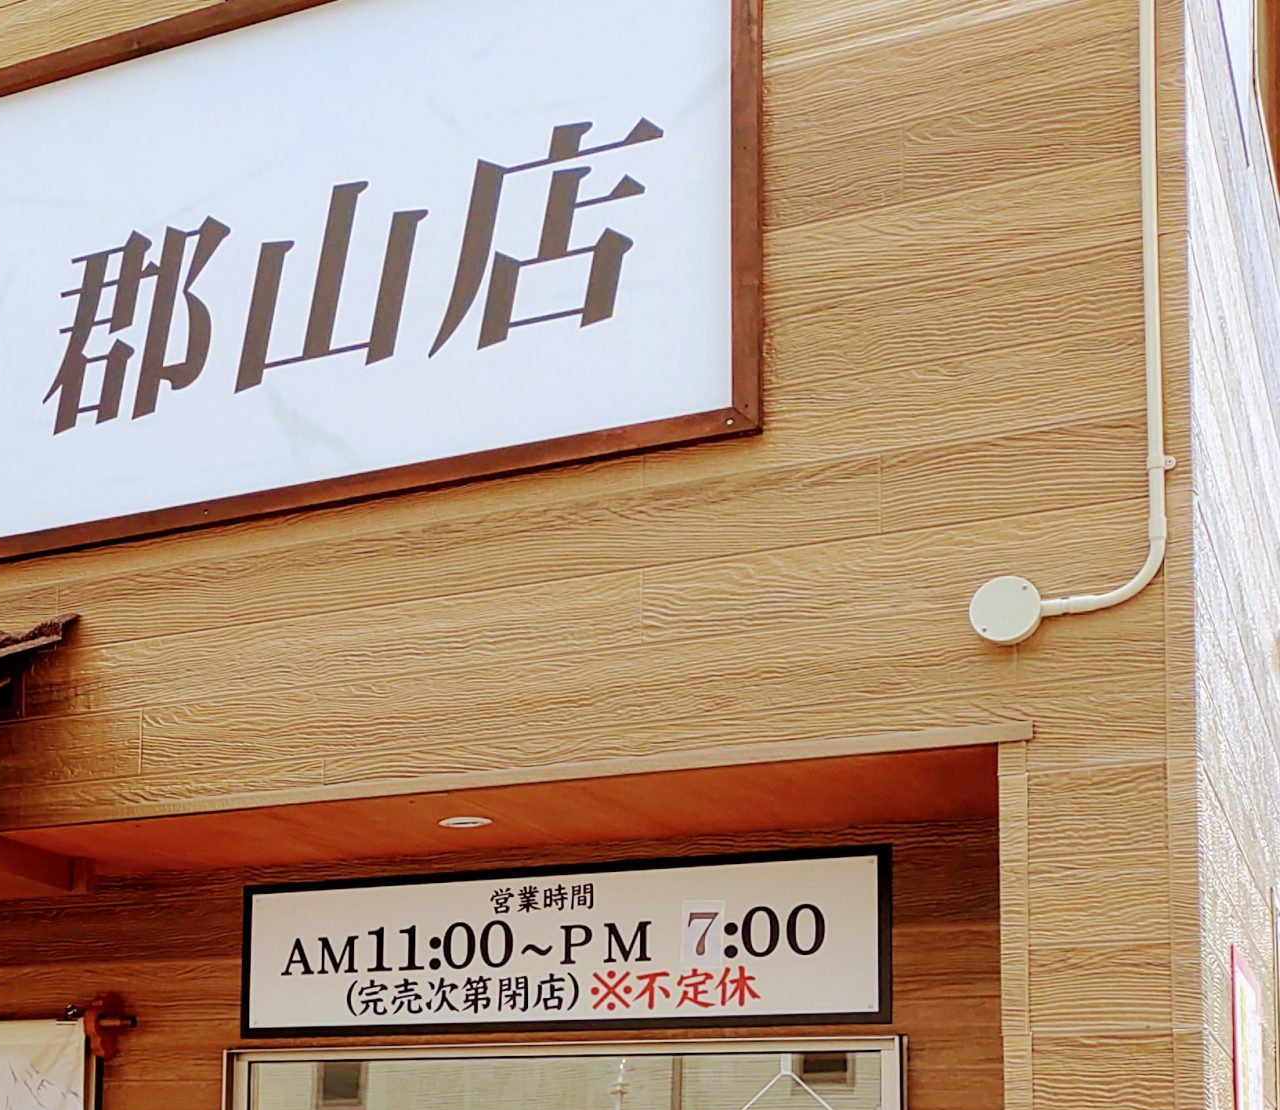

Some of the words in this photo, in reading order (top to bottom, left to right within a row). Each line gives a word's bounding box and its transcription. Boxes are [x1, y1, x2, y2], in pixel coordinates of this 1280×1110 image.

[42, 117, 664, 437] 郡山店
[489, 883, 595, 913] 営業時間
